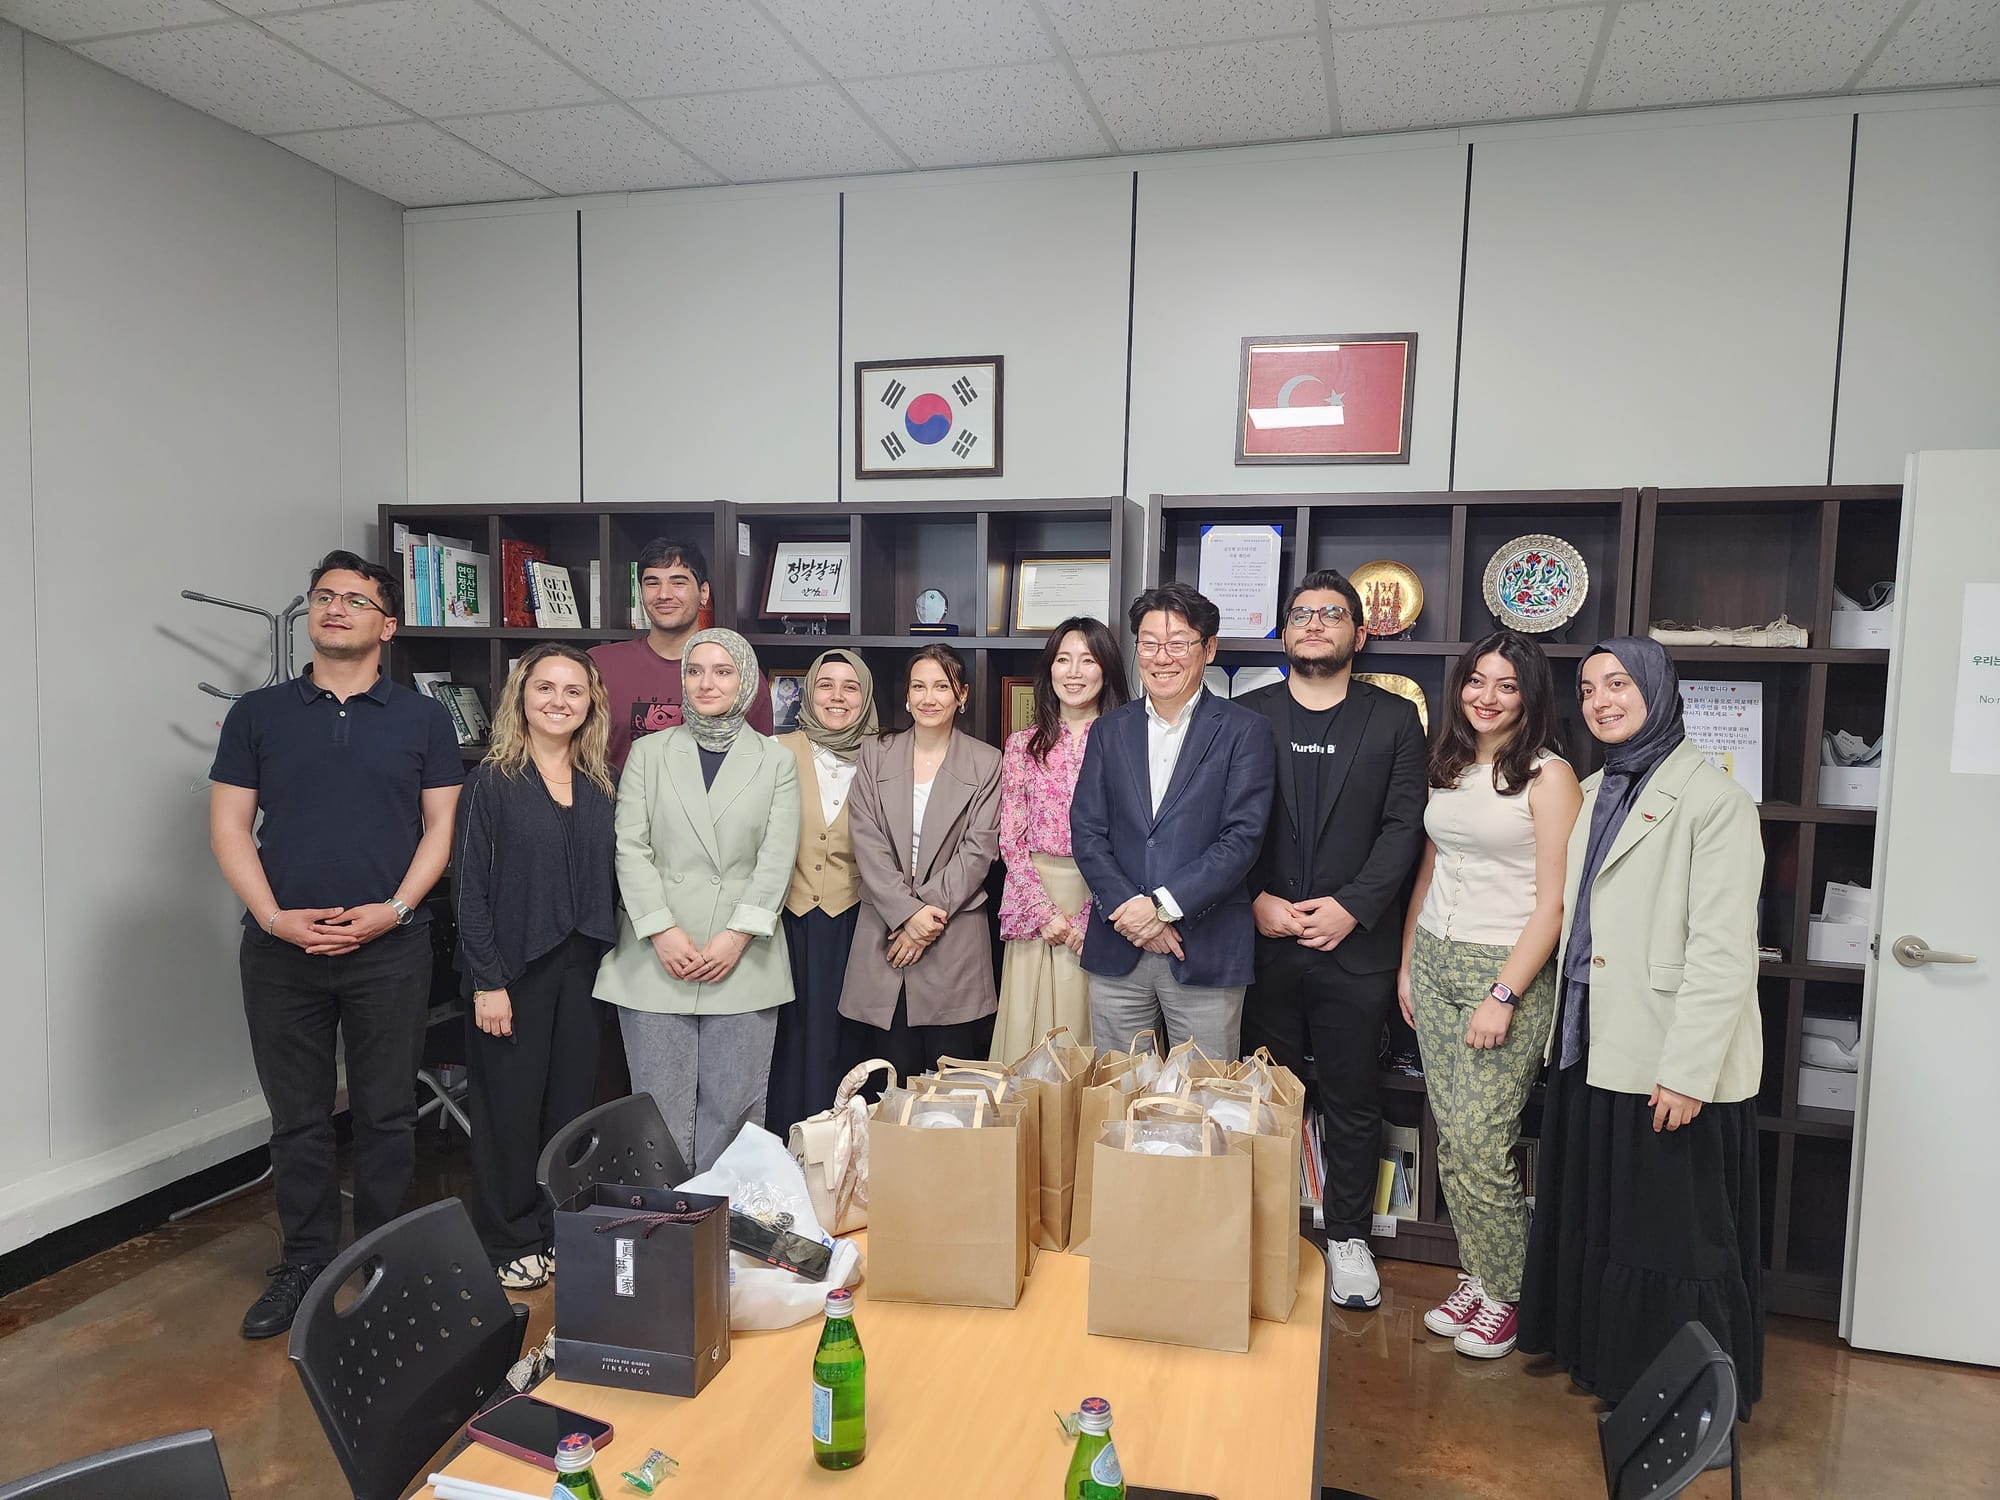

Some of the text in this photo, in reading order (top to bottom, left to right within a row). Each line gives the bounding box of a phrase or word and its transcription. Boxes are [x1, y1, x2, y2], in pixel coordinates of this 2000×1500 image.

[457, 566, 475, 579] 연말
[787, 557, 843, 595] 정말잘돼
[457, 578, 475, 591] 정산
[543, 577, 568, 591] GET
[457, 590, 476, 604] 실무
[546, 590, 567, 602] MO
[549, 602, 574, 615] NEY
[1972, 655, 2000, 666] 우리는
[636, 696, 673, 704] LUF
[1979, 695, 1995, 704] No
[1327, 744, 1336, 754] B
[601, 1363, 650, 1376] JINSAMGA
